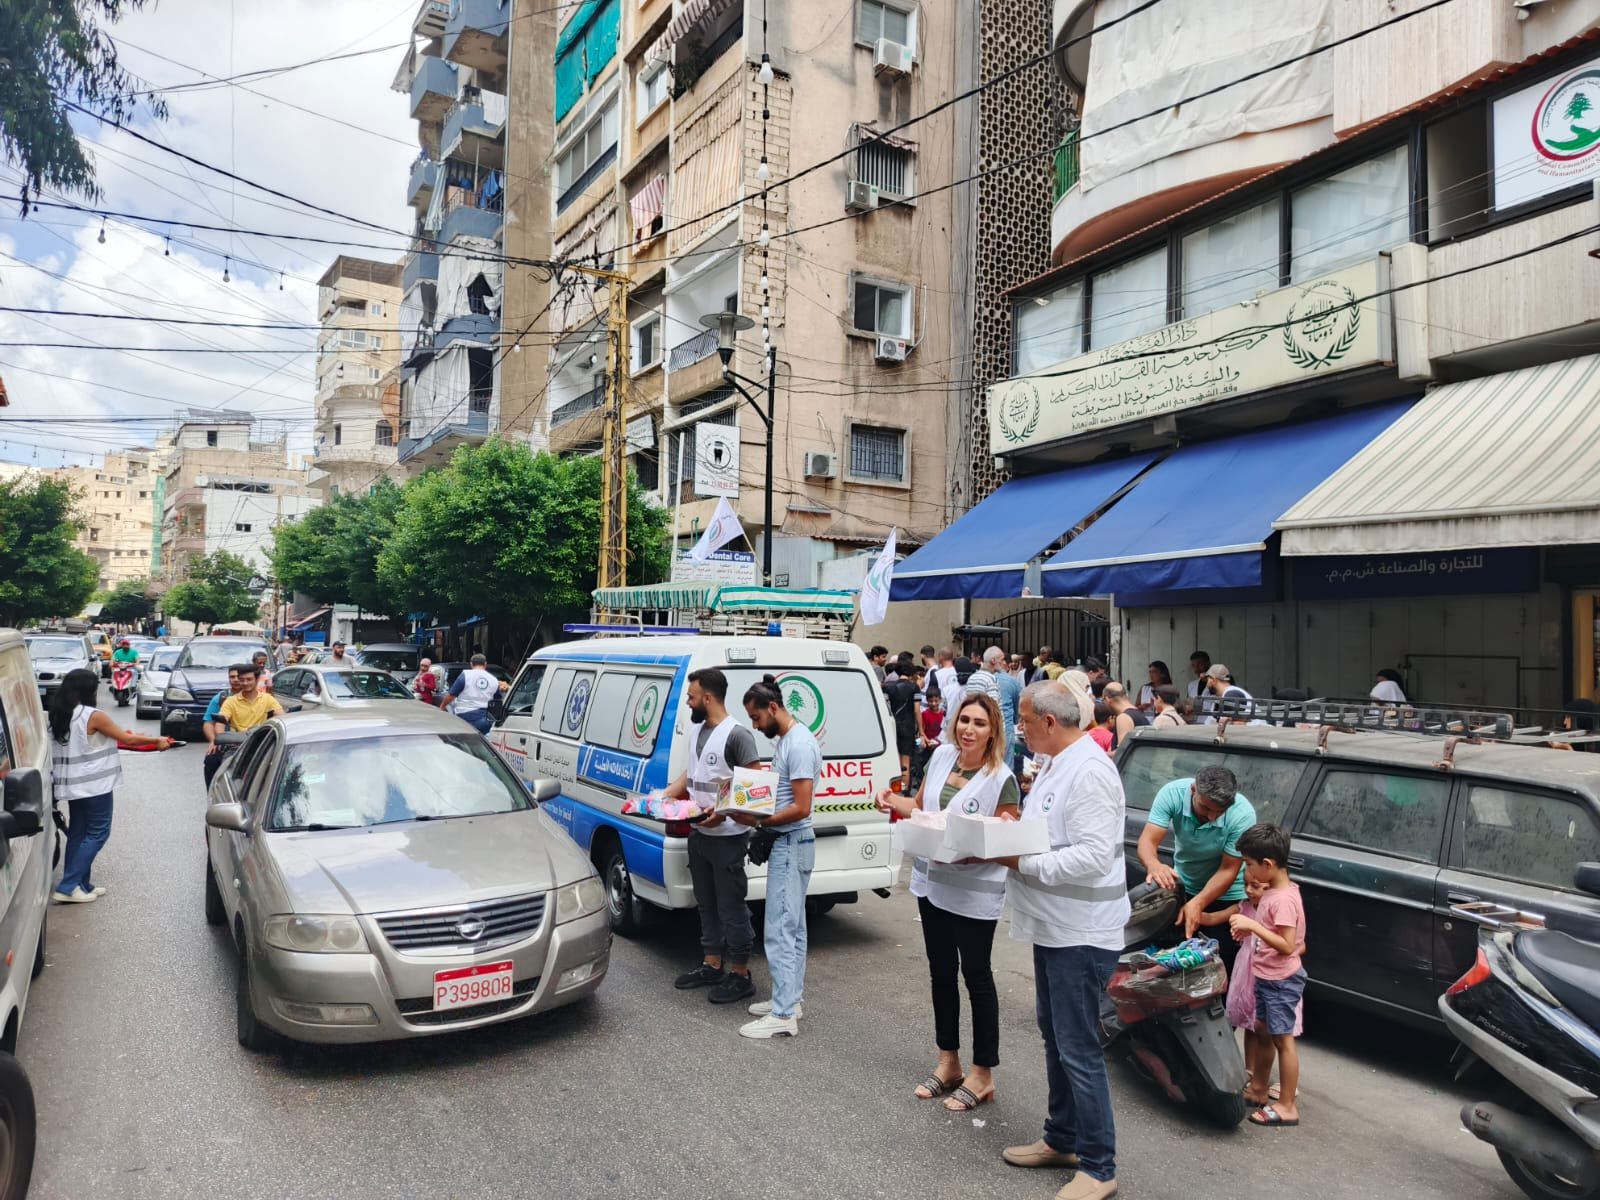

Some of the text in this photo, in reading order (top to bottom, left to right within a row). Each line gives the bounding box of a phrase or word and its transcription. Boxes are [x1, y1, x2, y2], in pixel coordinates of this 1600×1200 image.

[1207, 333, 1268, 361] مركز
[1157, 350, 1210, 376] خدمة
[1050, 376, 1104, 404] الكريم
[1190, 387, 1219, 404] الشهيد
[734, 552, 752, 562] Care
[1377, 559, 1435, 576] والصناعة
[1440, 554, 1483, 574] للتجارة
[436, 975, 511, 1007] P399808
